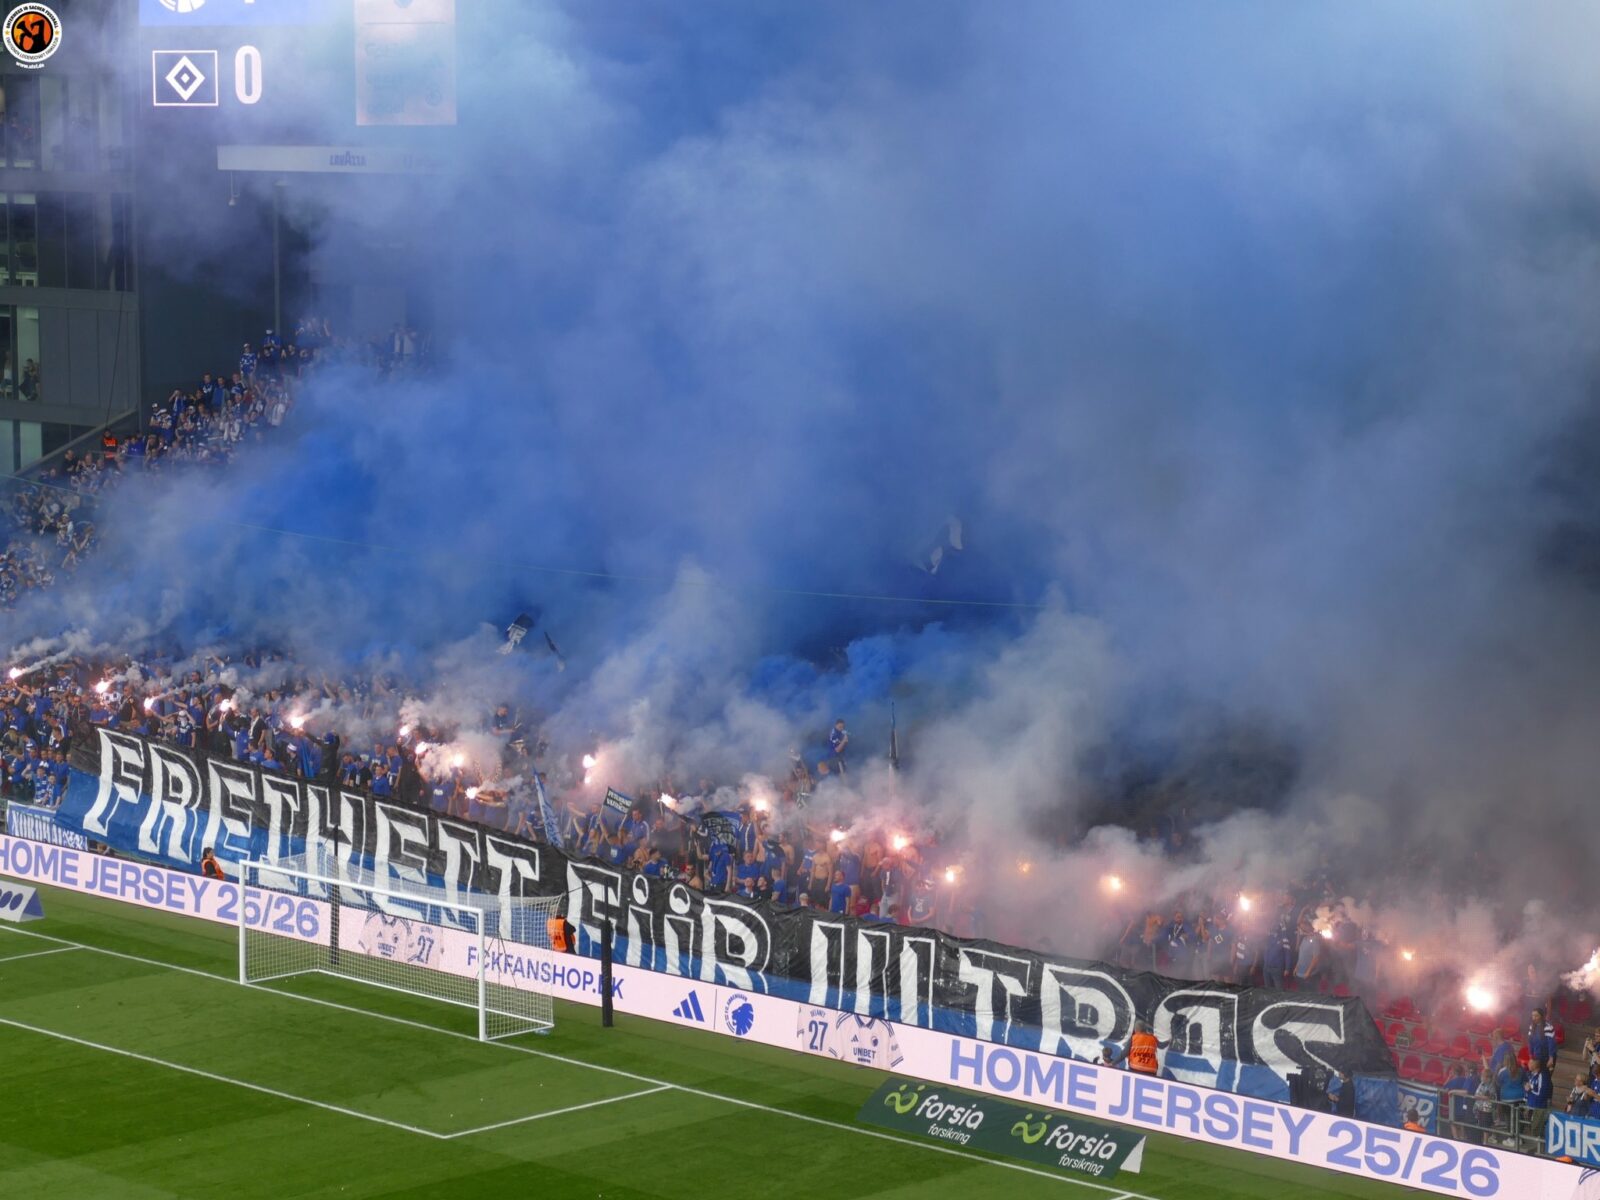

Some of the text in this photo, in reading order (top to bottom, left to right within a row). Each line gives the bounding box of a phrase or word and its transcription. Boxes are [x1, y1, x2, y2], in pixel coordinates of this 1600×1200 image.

[235, 45, 263, 104] 0
[85, 849, 210, 913] JERSEY
[216, 880, 320, 937] 25/26
[808, 1020, 829, 1051] 27
[853, 1047, 876, 1059] UNIBET
[915, 1094, 1118, 1161] forsia forsia
[927, 1124, 971, 1145] forsikring
[950, 1039, 1501, 1198] HOME JERSEY 25/26
[1058, 1153, 1105, 1176] forsikring
